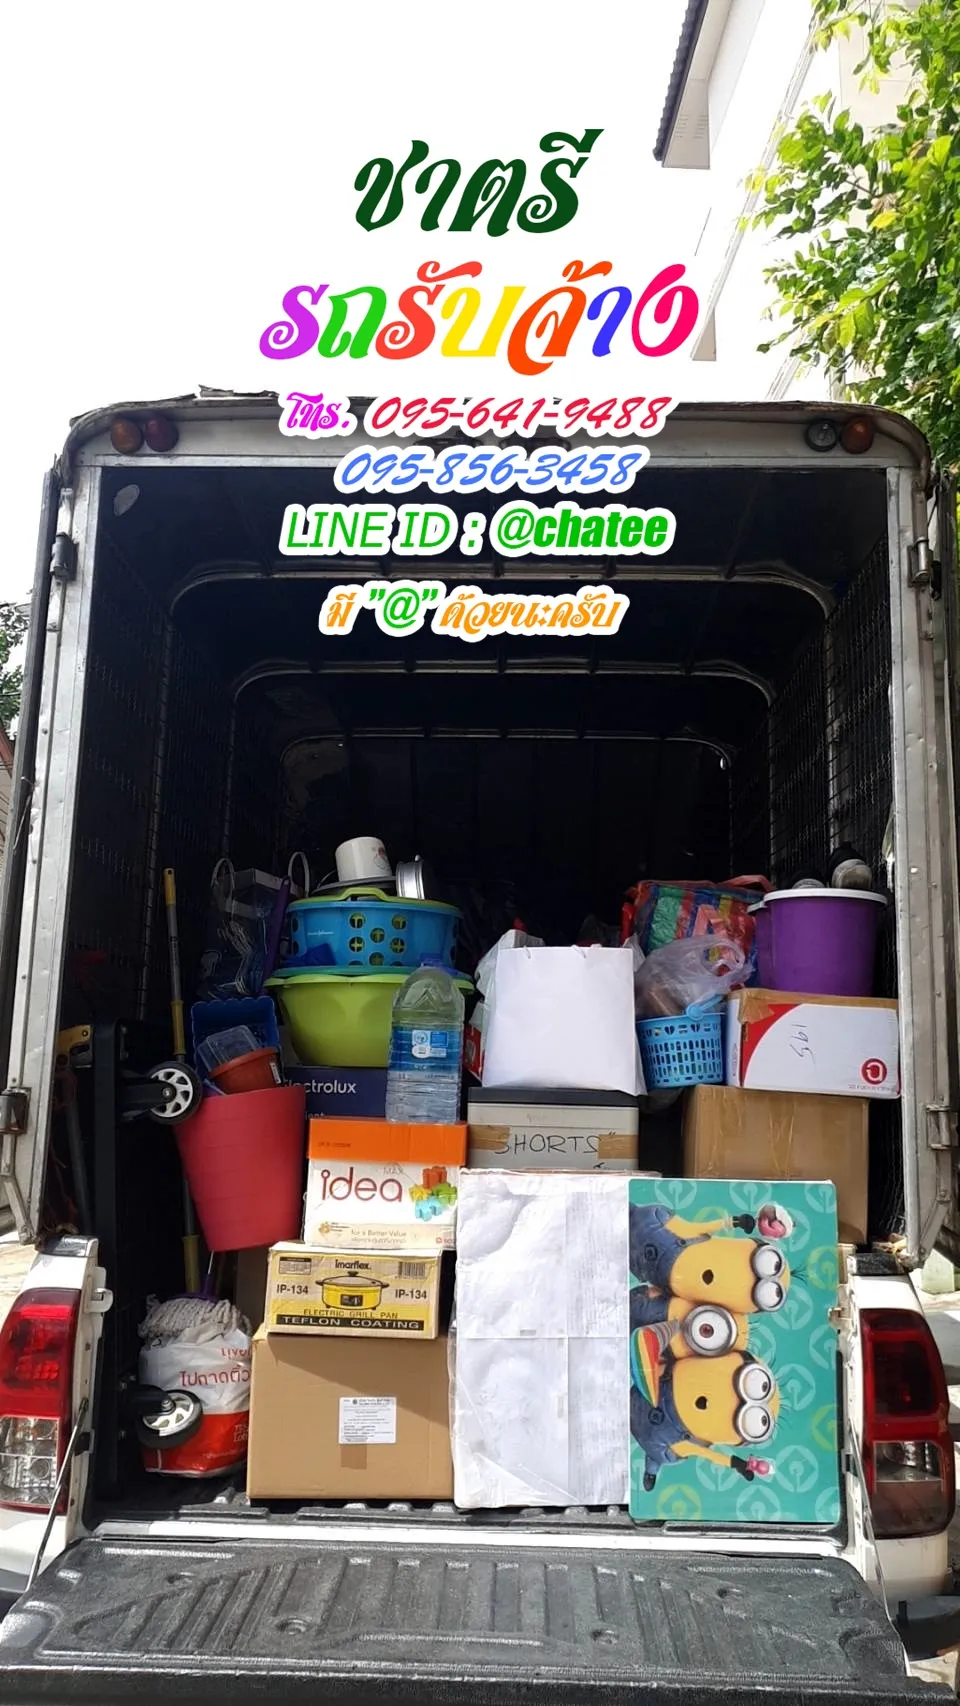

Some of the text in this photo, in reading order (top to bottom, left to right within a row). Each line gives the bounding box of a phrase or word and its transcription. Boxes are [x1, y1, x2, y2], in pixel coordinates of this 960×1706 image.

[320, 1166, 403, 1202] idea
[389, 1230, 407, 1238] Value
[276, 1283, 309, 1295] IP-134
[395, 1288, 428, 1300] IP-134
[303, 1308, 399, 1320] ELECTRIC GRILL PAN
[282, 1315, 420, 1329] TEFLON COATING
